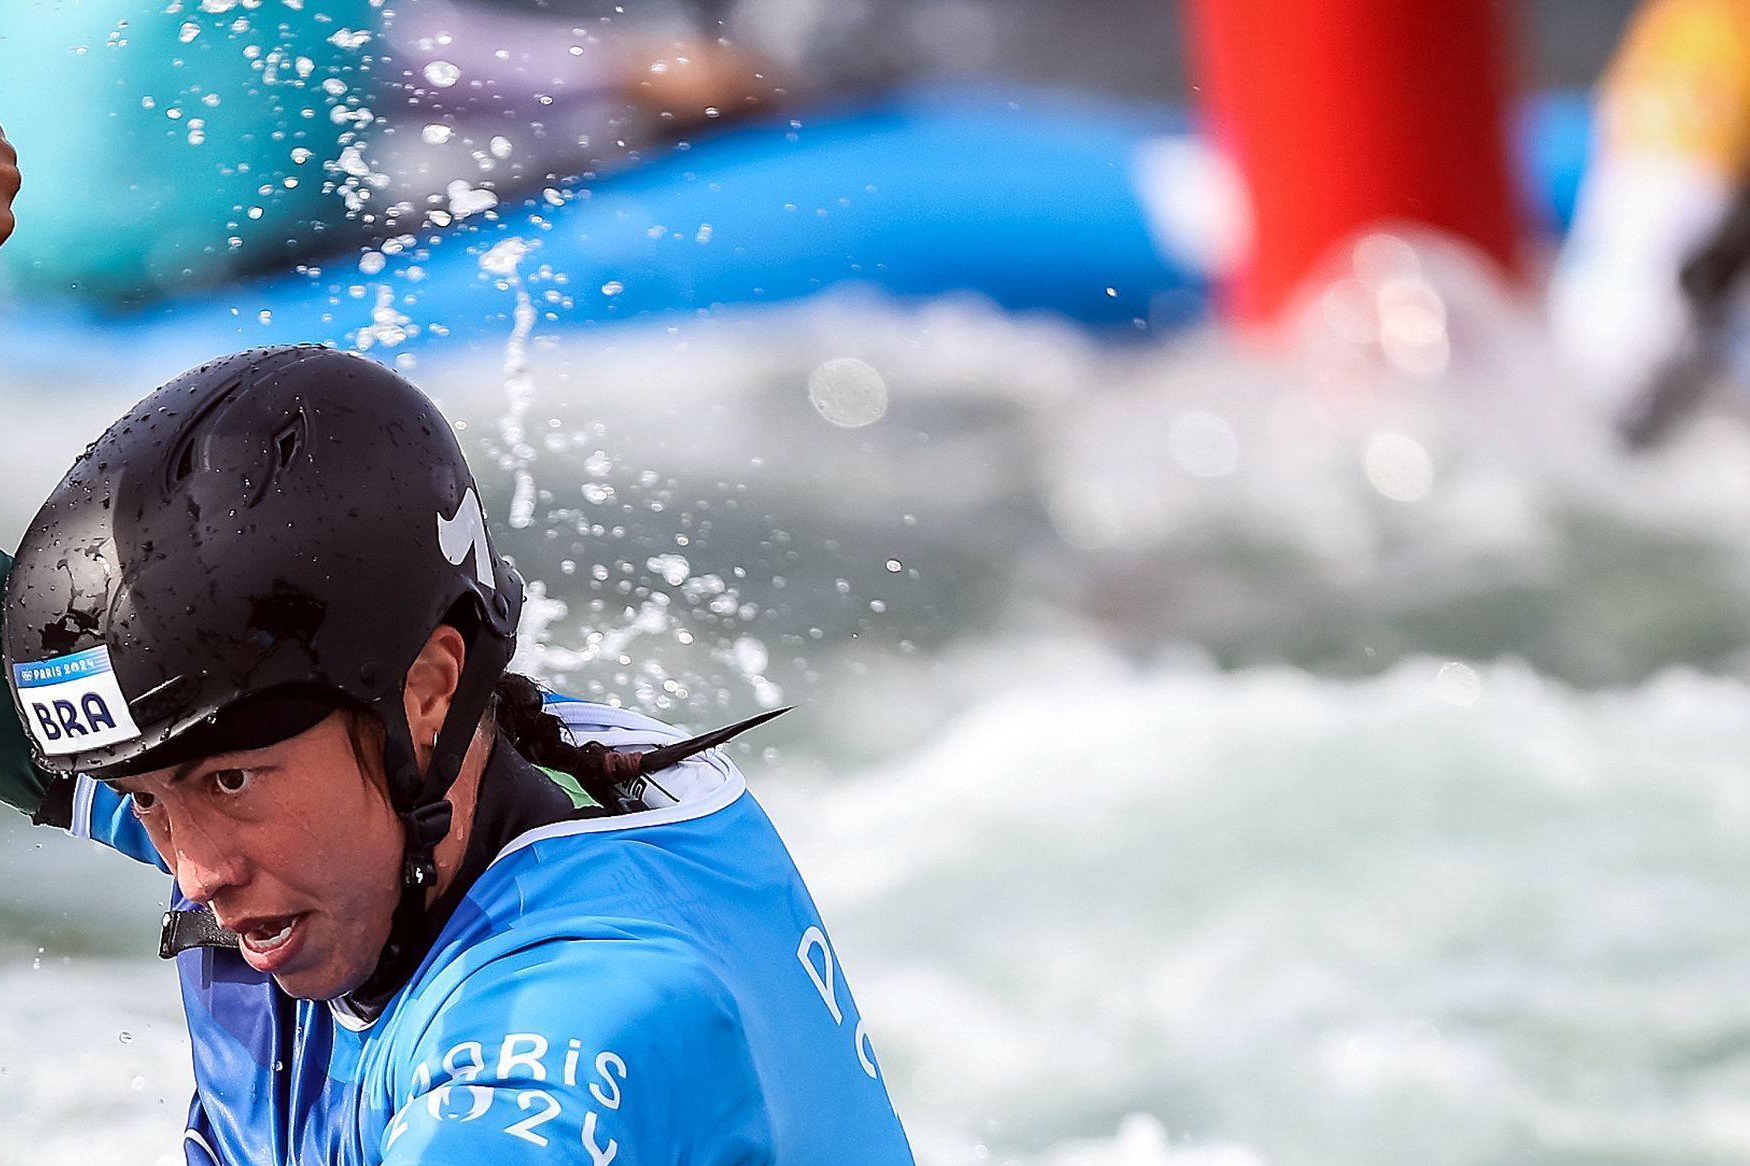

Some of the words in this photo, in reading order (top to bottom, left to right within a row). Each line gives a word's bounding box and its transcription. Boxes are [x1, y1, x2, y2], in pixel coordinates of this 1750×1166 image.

[33, 666, 62, 681] PARIS
[63, 659, 95, 674] 2024
[32, 691, 117, 740] BRA
